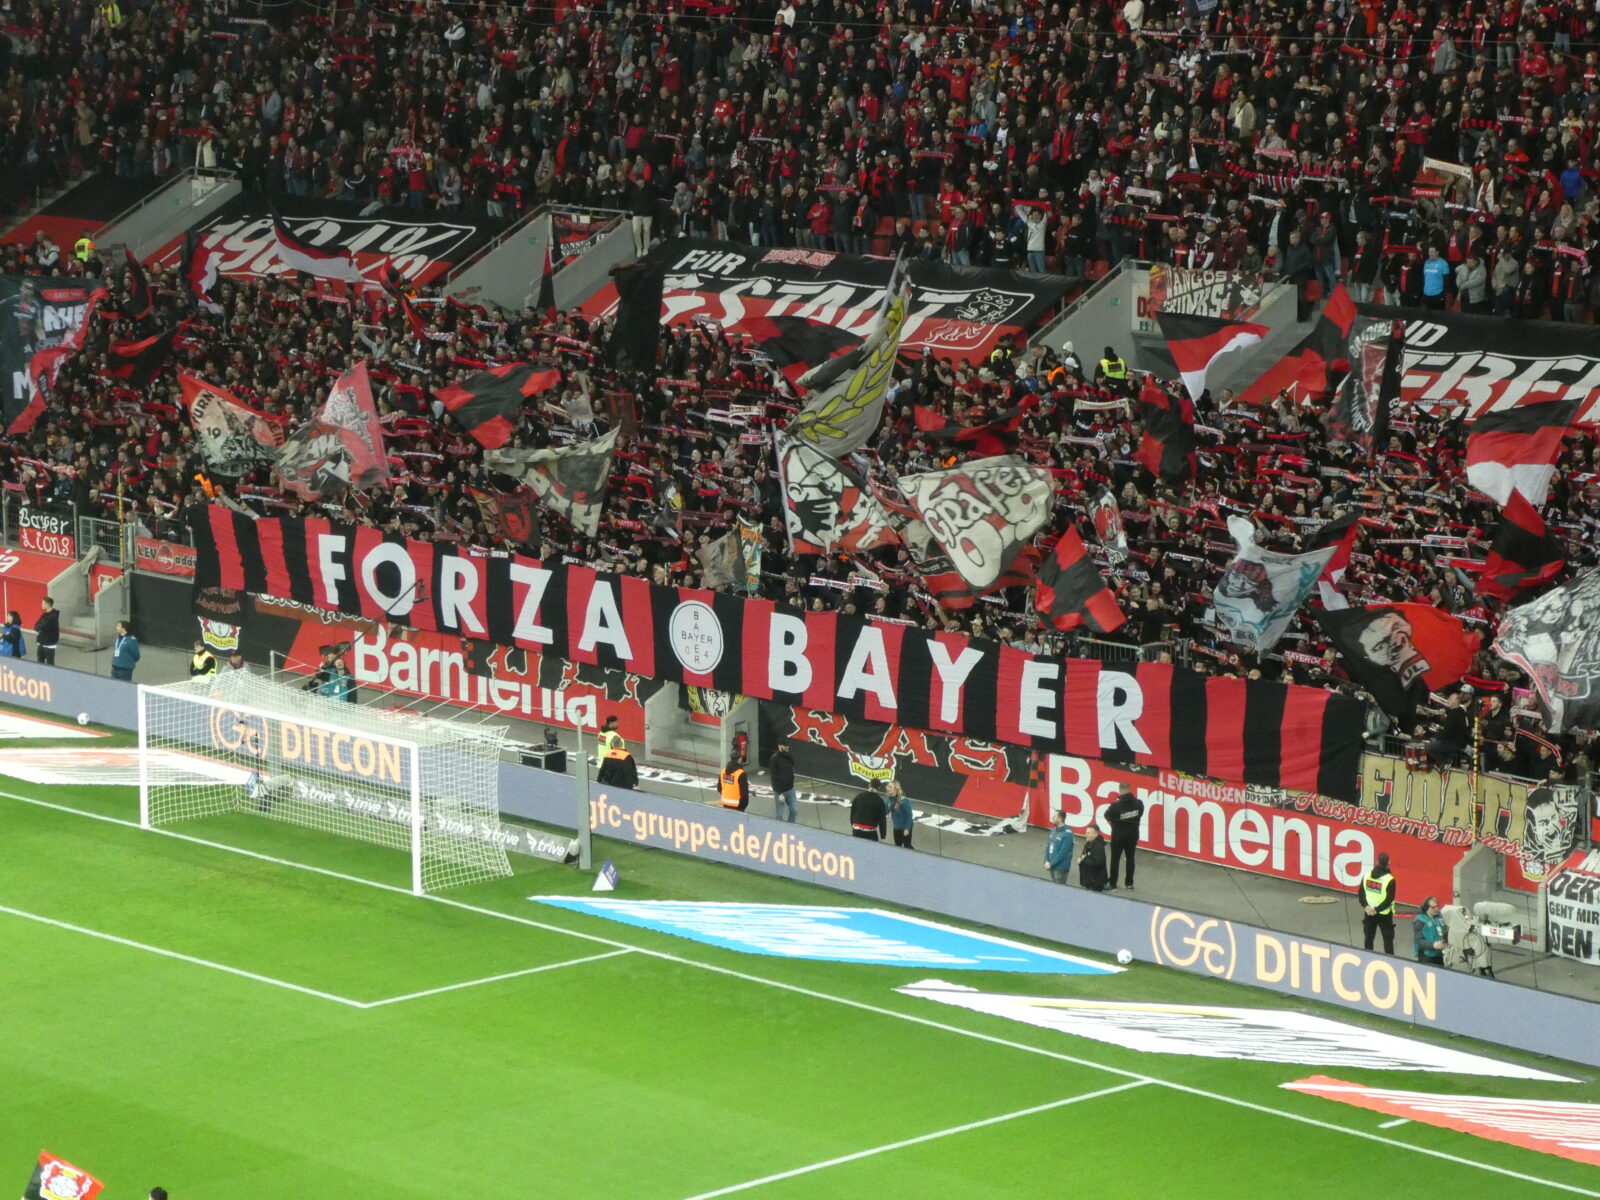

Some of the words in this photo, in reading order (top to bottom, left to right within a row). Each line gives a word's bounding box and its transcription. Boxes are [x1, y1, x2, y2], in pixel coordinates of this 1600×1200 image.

[671, 248, 747, 276] FÜR
[708, 278, 972, 343] STADT
[18, 507, 70, 535] Bayer
[21, 529, 70, 557] Lions
[137, 544, 158, 559] LEV
[317, 532, 634, 662] FORZA
[681, 630, 713, 645] BAYER
[693, 610, 701, 665] BAYER
[767, 610, 1154, 755] BAYER
[280, 722, 401, 784] DITCON
[854, 763, 890, 779] Leverkusen
[1158, 771, 1247, 805] LEVERKUSEN
[354, 796, 382, 814] trive
[397, 806, 425, 825] trie
[1048, 753, 1375, 888] Barmenia
[1294, 791, 1439, 842] Ausgesperrte
[1443, 824, 1475, 847] mi
[492, 829, 520, 846] trive
[537, 838, 566, 857] trive
[588, 794, 855, 881] gfc-gruppe.de/ditcon
[1549, 872, 1600, 905] DER
[1548, 901, 1575, 920] GEHT
[1576, 907, 1600, 926] MIR
[1549, 920, 1594, 960] DEN
[1255, 932, 1437, 1021] DITCON
